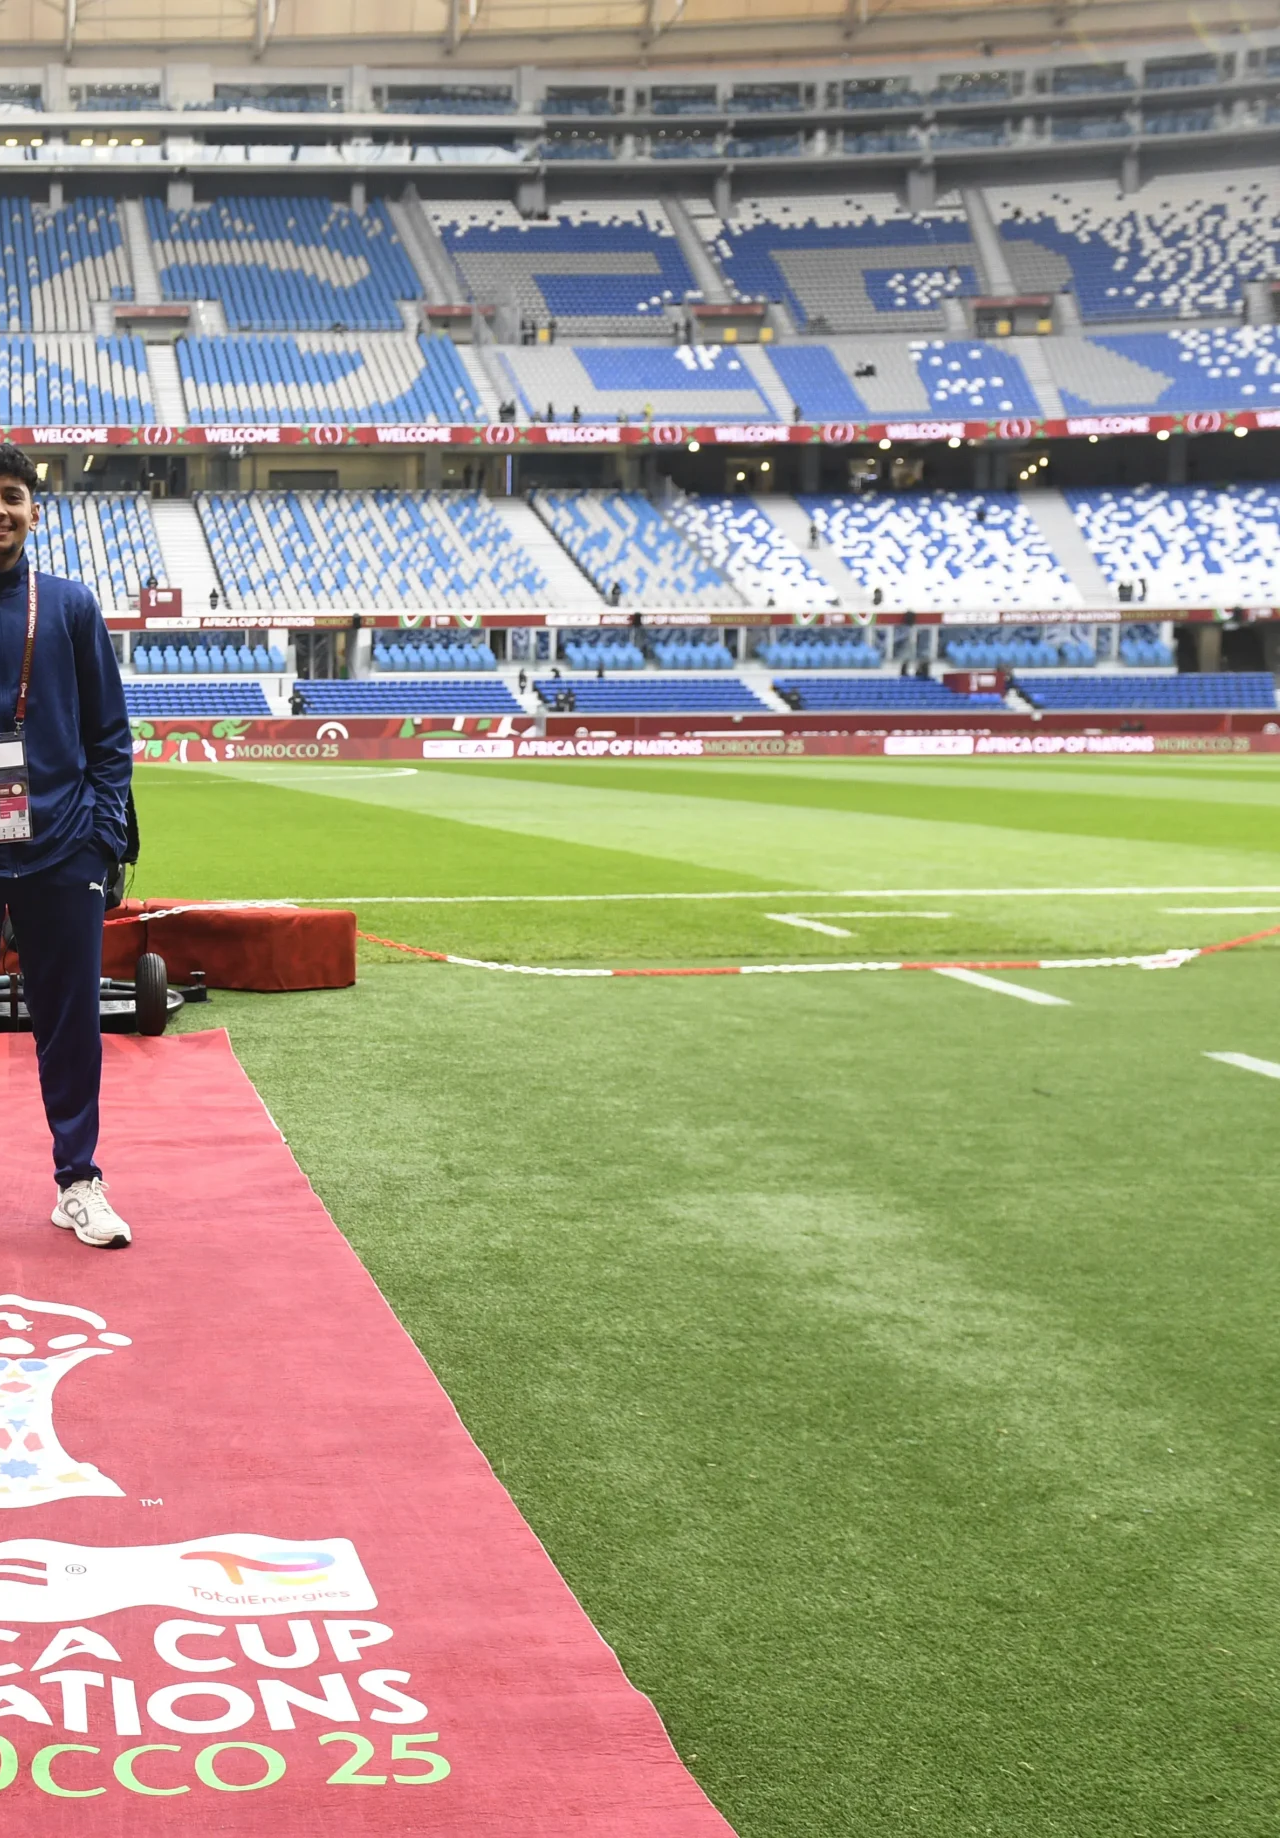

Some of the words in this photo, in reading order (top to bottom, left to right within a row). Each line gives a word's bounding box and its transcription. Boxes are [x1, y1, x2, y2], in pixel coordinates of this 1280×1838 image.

[714, 425, 790, 441] WELCOME
[885, 422, 966, 439] WELCOME
[1066, 416, 1150, 434] WELCOME
[32, 428, 108, 443] WELCOME
[205, 427, 280, 442] WELCOME
[376, 427, 451, 442] WELCOME
[546, 427, 621, 442] WELCOME
[202, 617, 238, 627] AFRICA
[238, 617, 258, 627] CUP
[258, 617, 272, 627] OF
[272, 617, 315, 627] NATIONS
[236, 743, 319, 757] MOROCCO
[321, 743, 339, 757] 25
[458, 744, 501, 754] CAF
[517, 741, 576, 756] AFRICA
[576, 740, 609, 756] CUP
[609, 740, 633, 756] OF
[633, 739, 703, 756] NATIONS
[704, 739, 785, 754] MOROCCO
[786, 739, 805, 754] 25
[975, 736, 1033, 753] AFRICA
[1032, 736, 1065, 753] CUP
[1064, 736, 1086, 753] OF
[1086, 735, 1155, 753] NATIONS
[188, 1585, 351, 1605] TotalEnergies
[152, 1618, 394, 1673] CUP
[316, 1731, 452, 1786] 25
